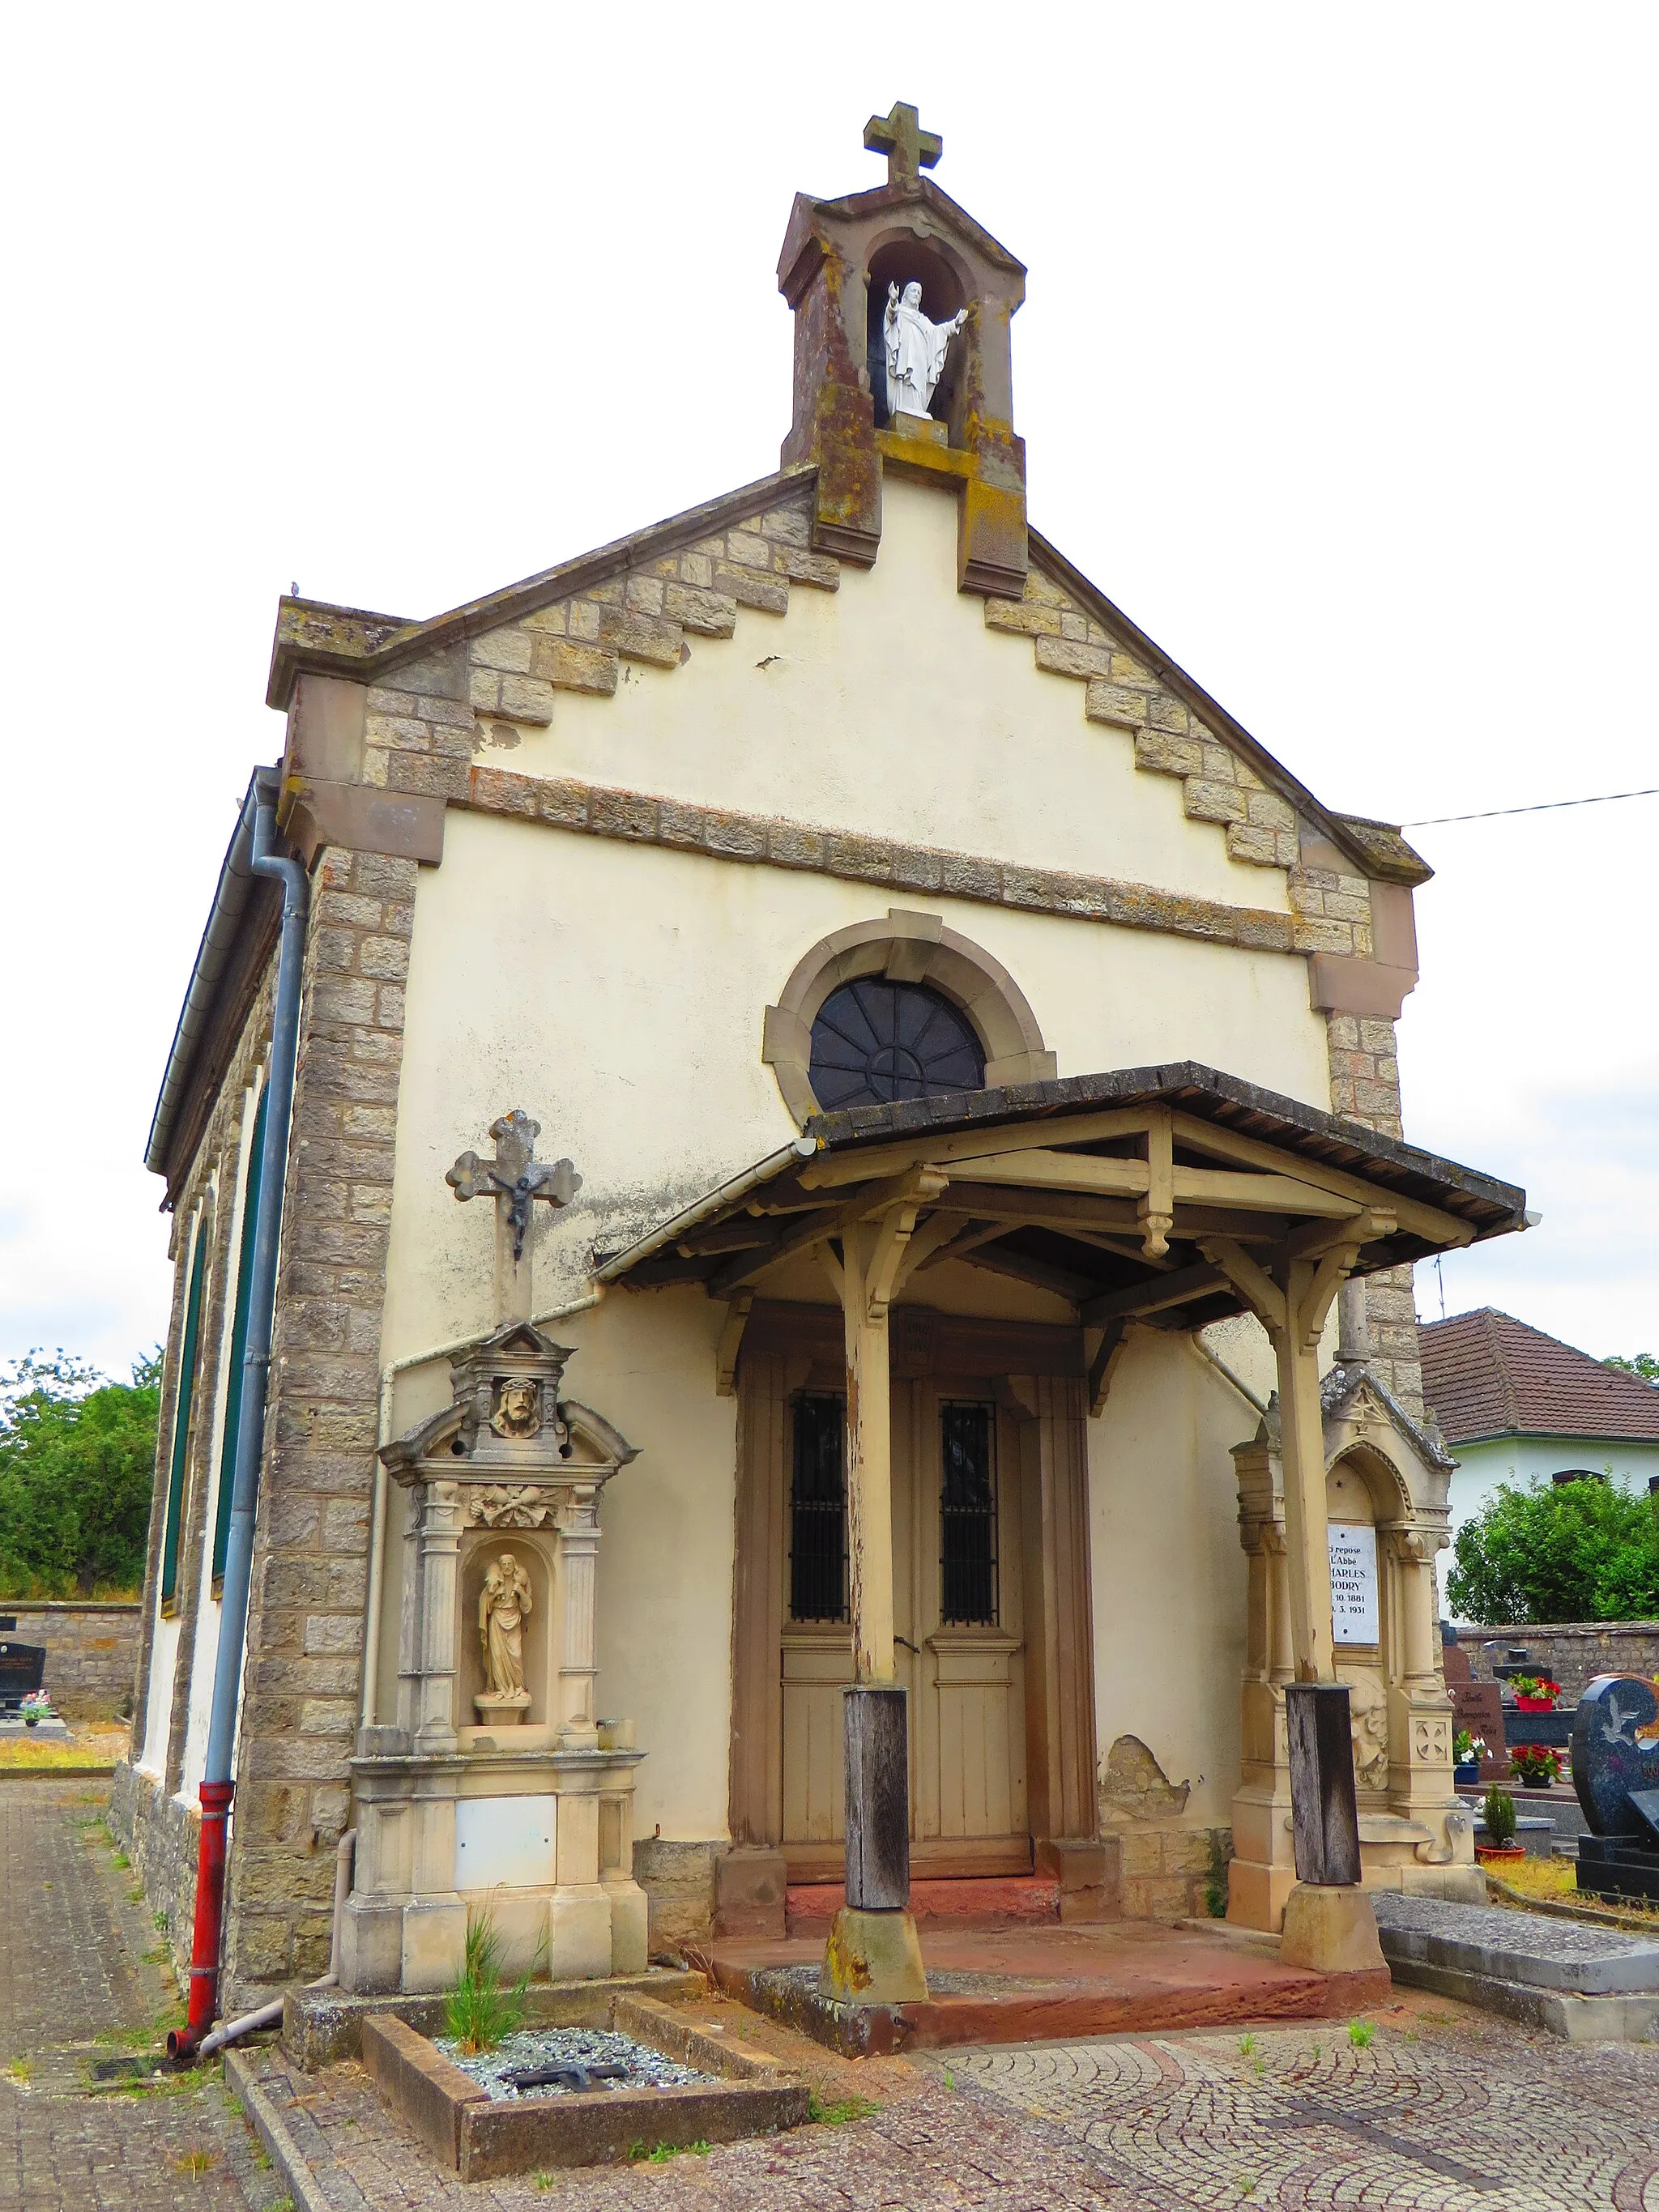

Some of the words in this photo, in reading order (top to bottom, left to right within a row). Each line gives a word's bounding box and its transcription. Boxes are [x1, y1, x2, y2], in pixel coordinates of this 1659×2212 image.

[1335, 1547, 1361, 1555] repose
[1331, 1554, 1357, 1565] L'Abbé
[1329, 1567, 1366, 1579] HARLES
[1347, 1594, 1365, 1603] 1881
[1339, 1605, 1346, 1613] 3.
[1349, 1606, 1366, 1614] 1931
